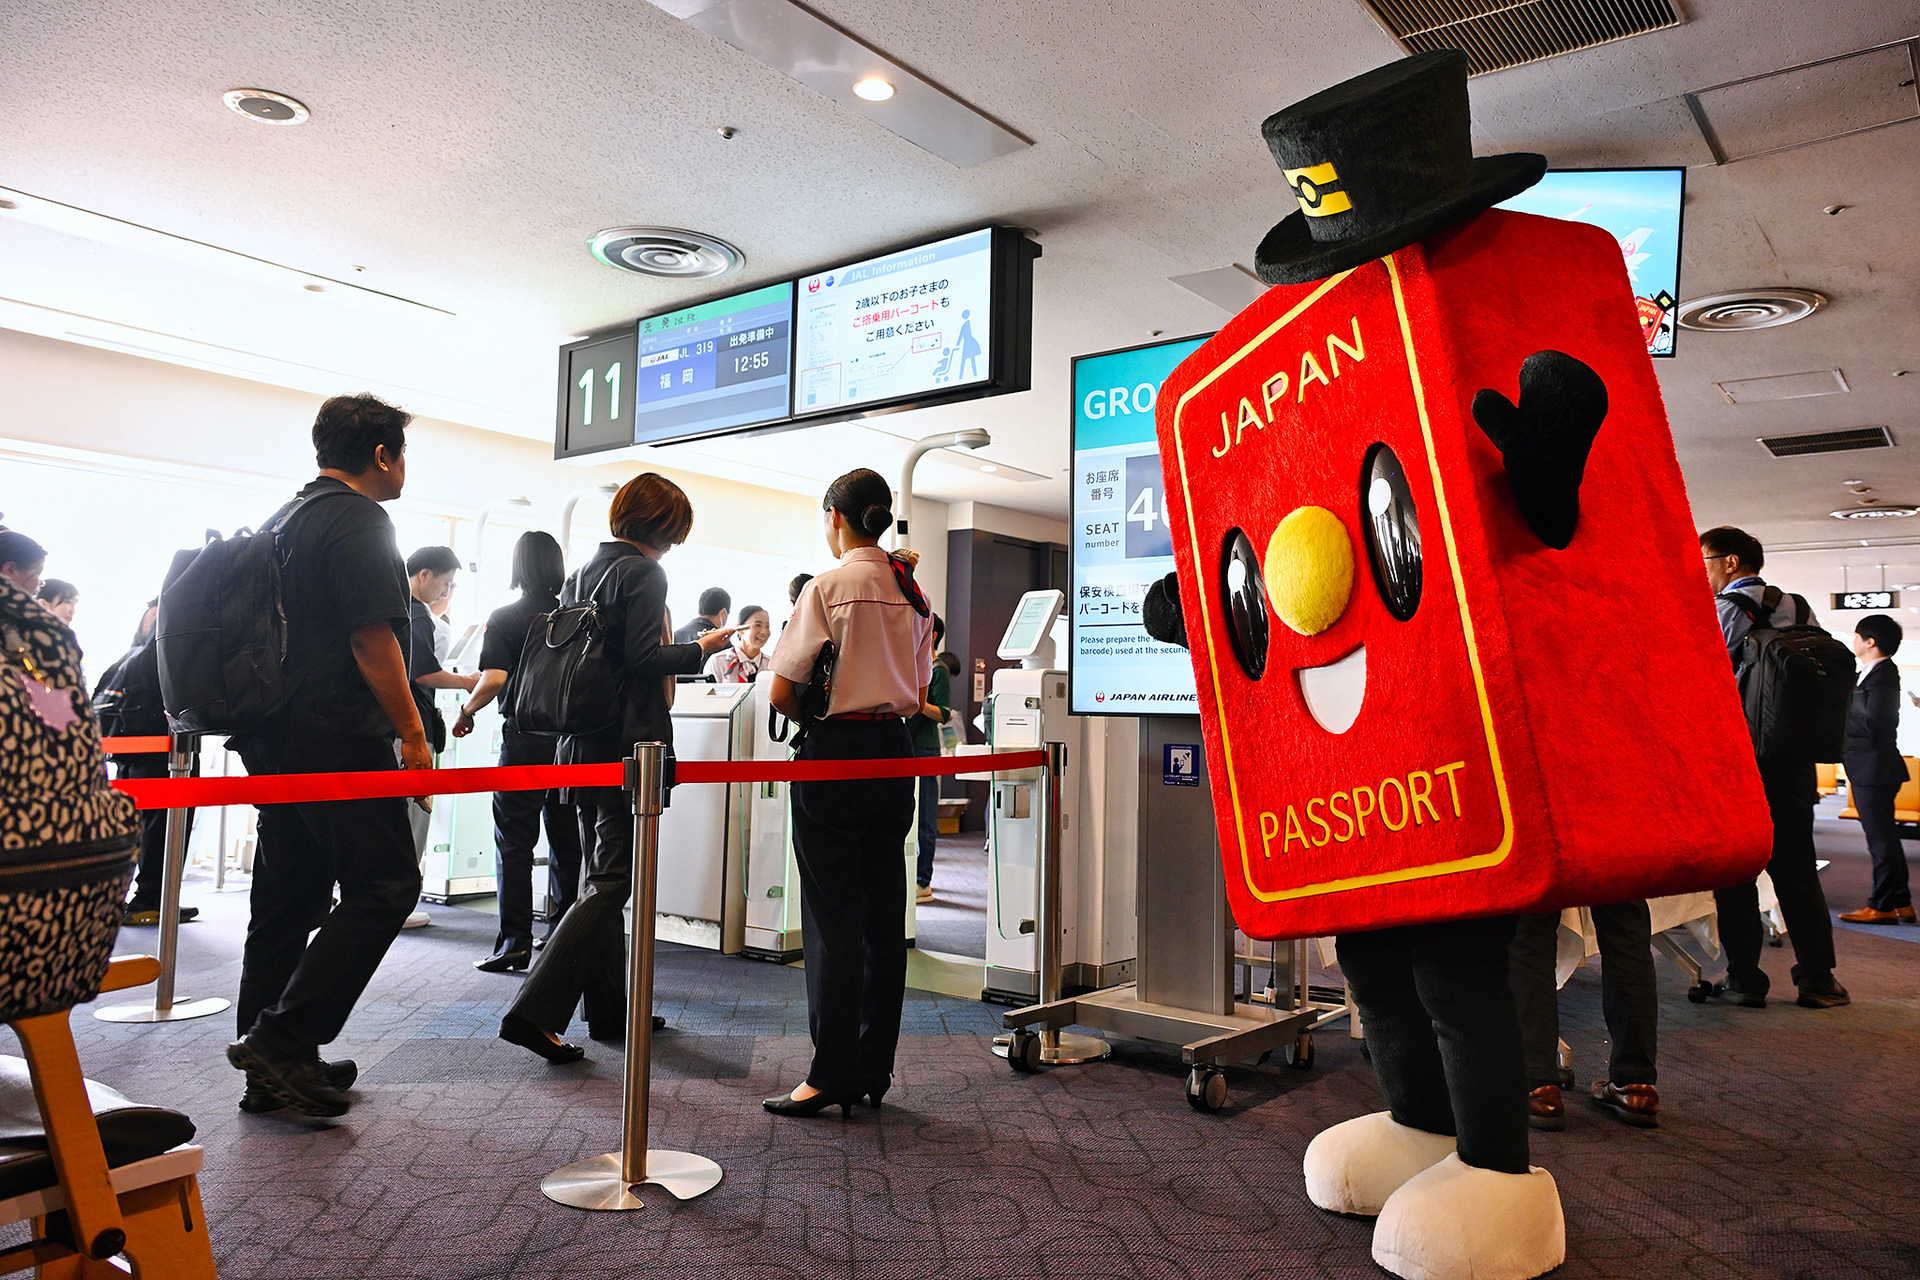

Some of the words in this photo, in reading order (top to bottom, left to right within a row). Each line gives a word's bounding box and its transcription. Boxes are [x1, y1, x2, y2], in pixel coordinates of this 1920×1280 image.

[849, 269, 869, 283] JAL
[872, 252, 936, 277] Information
[855, 279, 949, 310] 2歳以下のお子さまの
[852, 297, 950, 328] ご搭乗用バーコードも
[729, 326, 774, 348] 出発準備中
[866, 319, 935, 343] ご用意ください
[656, 354, 669, 363] JAL
[680, 349, 690, 359] JL
[696, 341, 714, 356] 319
[734, 351, 769, 373] 12:55
[659, 368, 694, 389] 福岡
[1211, 316, 1367, 459] JAPAN
[578, 361, 621, 426] 11
[1083, 381, 1164, 420] GRO
[1085, 469, 1120, 485] お座席
[1090, 487, 1114, 501] 番号
[1085, 522, 1120, 536] SEAT
[1085, 537, 1120, 549] number
[1079, 602, 1140, 615] バーコードを
[1080, 636, 1105, 644] Please
[1106, 636, 1136, 645] prepare
[1137, 635, 1151, 643] the
[1080, 647, 1113, 656] barcode)
[1115, 647, 1133, 655] used
[1145, 646, 1159, 654] the
[1110, 693, 1147, 701] JAPAN
[1148, 693, 1199, 701] AIRLINE
[1258, 759, 1468, 860] PASSPORT
